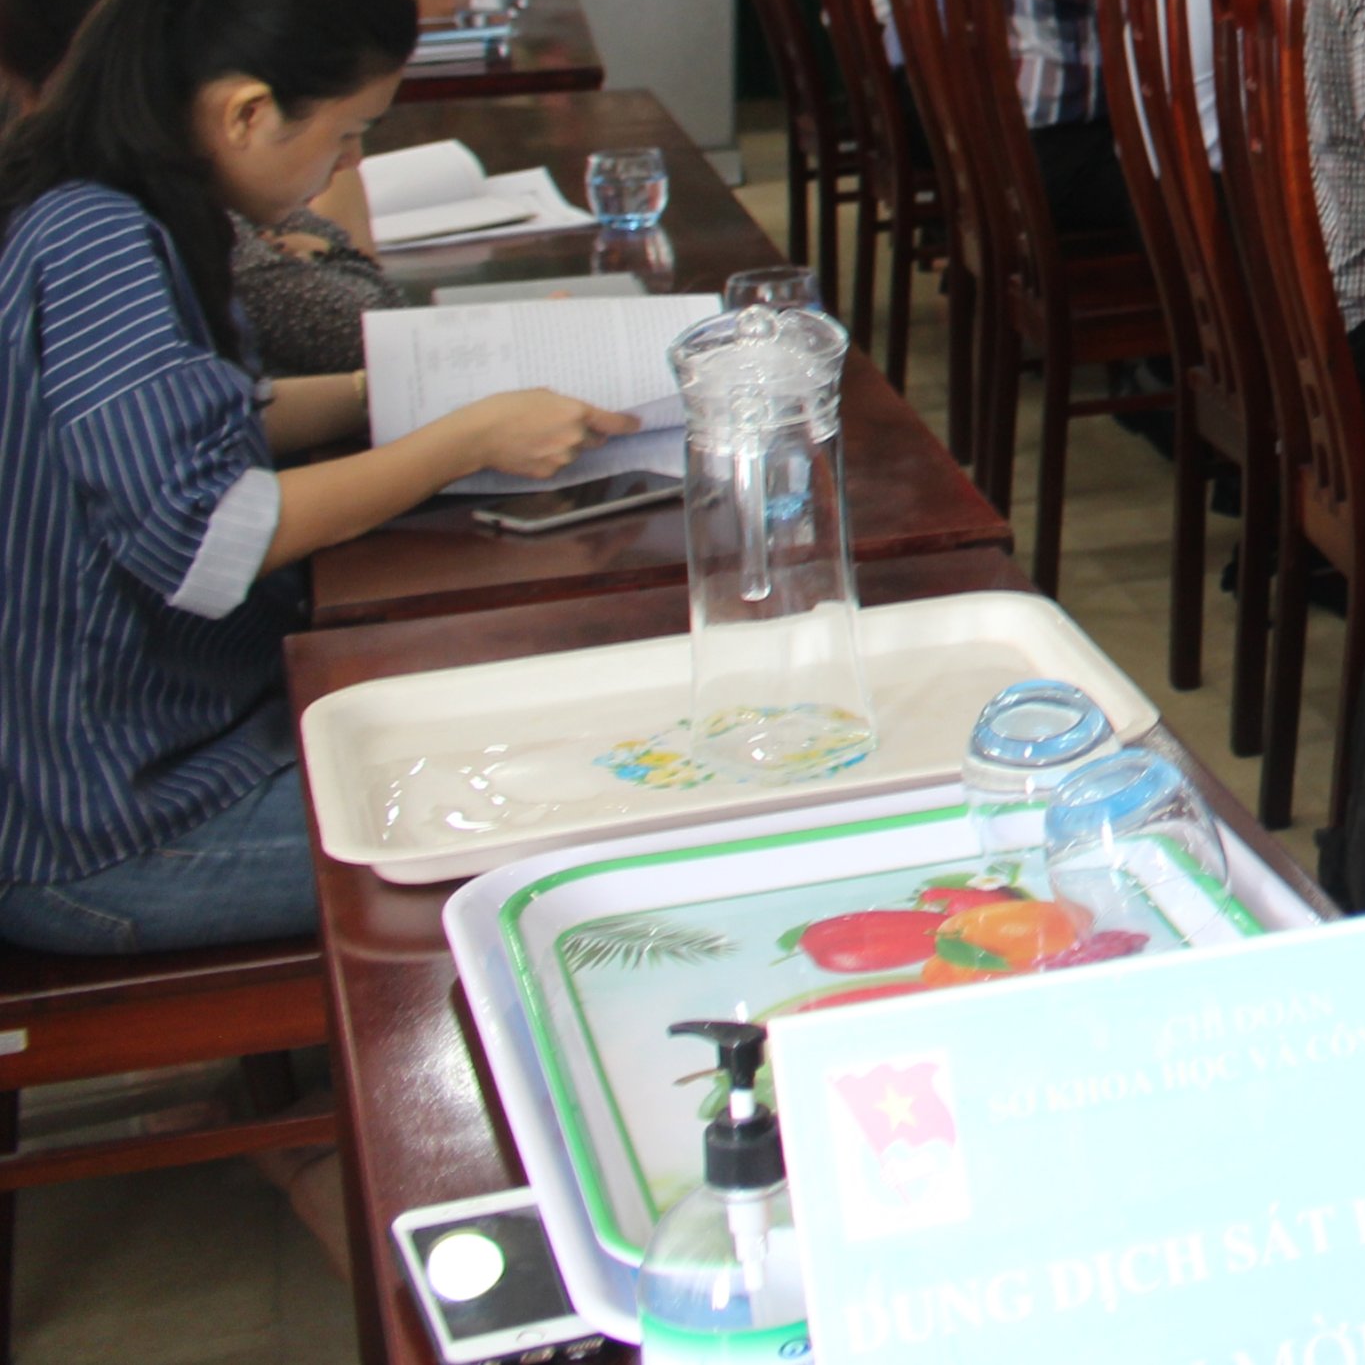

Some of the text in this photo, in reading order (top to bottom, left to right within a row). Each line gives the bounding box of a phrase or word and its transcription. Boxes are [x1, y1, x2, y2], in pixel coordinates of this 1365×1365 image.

[1045, 1068, 1154, 1114] KHOA
[1160, 1048, 1240, 1093] HỌC
[842, 1275, 1034, 1354] DUNG
[1048, 1234, 1208, 1313] DỊCH
[1223, 1202, 1337, 1276] SÁT
